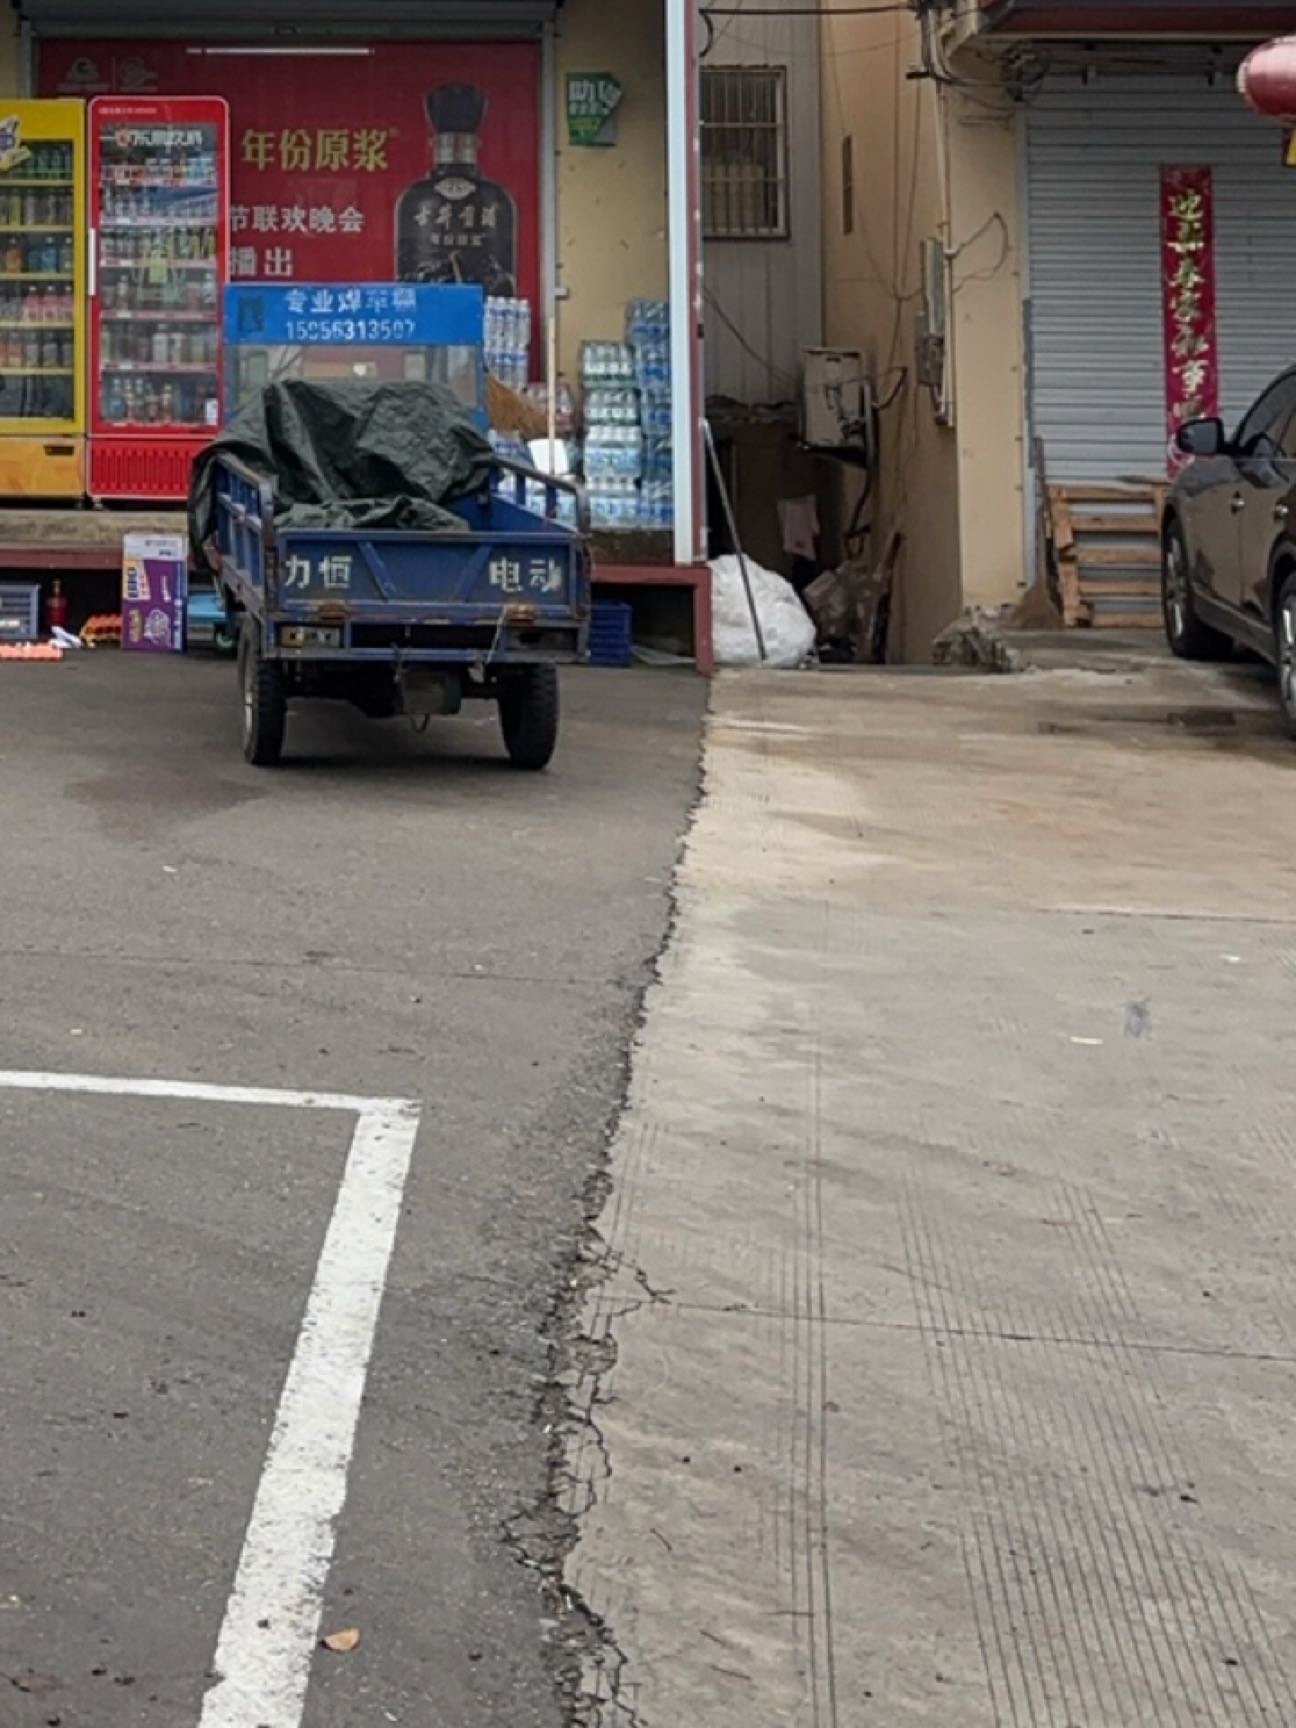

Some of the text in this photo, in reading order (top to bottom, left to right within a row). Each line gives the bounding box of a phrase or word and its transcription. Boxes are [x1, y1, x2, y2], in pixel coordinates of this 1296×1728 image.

[241, 128, 388, 171] 年份原浆
[284, 555, 352, 589] 力恒
[488, 556, 563, 593] 电动
